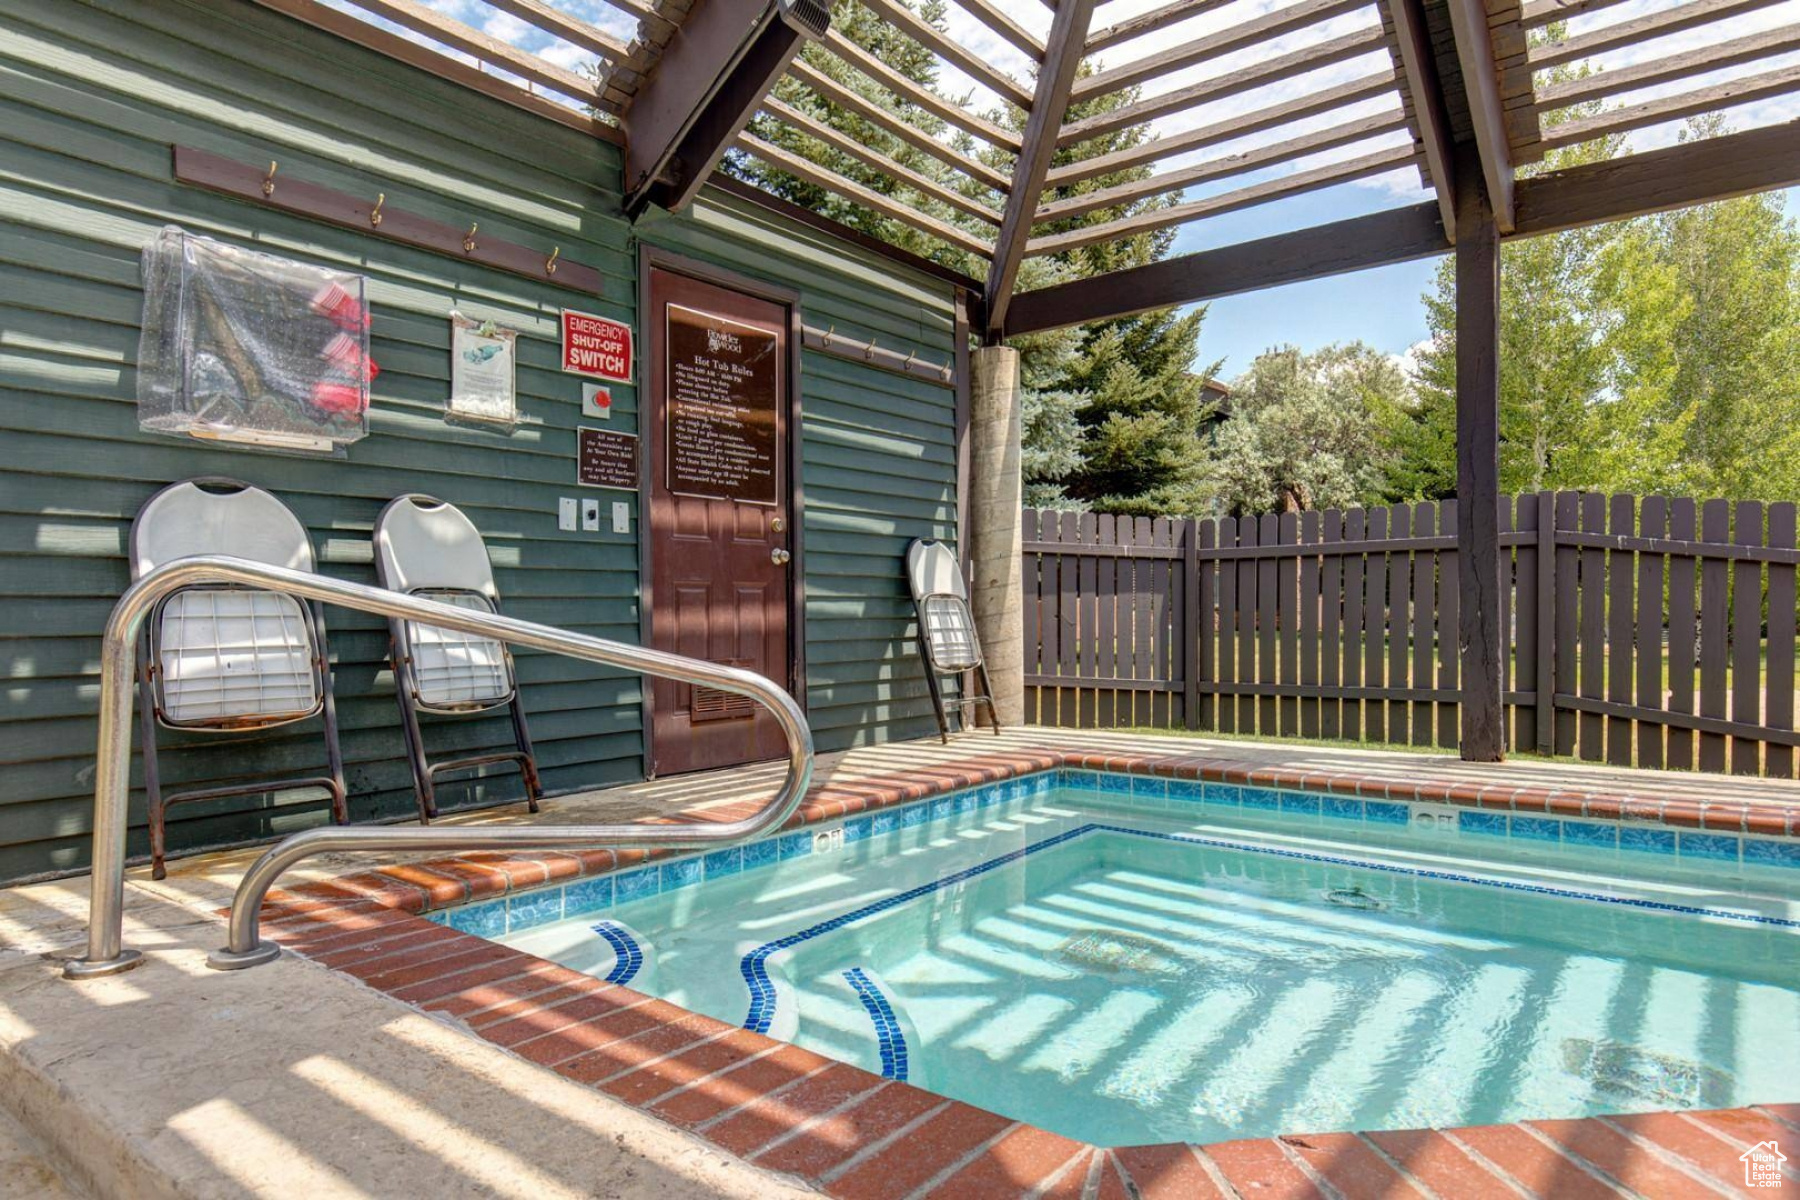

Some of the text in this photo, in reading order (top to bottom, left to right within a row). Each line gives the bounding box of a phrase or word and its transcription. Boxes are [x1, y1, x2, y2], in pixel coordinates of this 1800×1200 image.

[570, 317, 624, 340] EMERGENCY
[572, 333, 623, 354] SHUT-OFF
[570, 348, 624, 374] SWITCH
[694, 355, 753, 377] Hot Tub Rules
